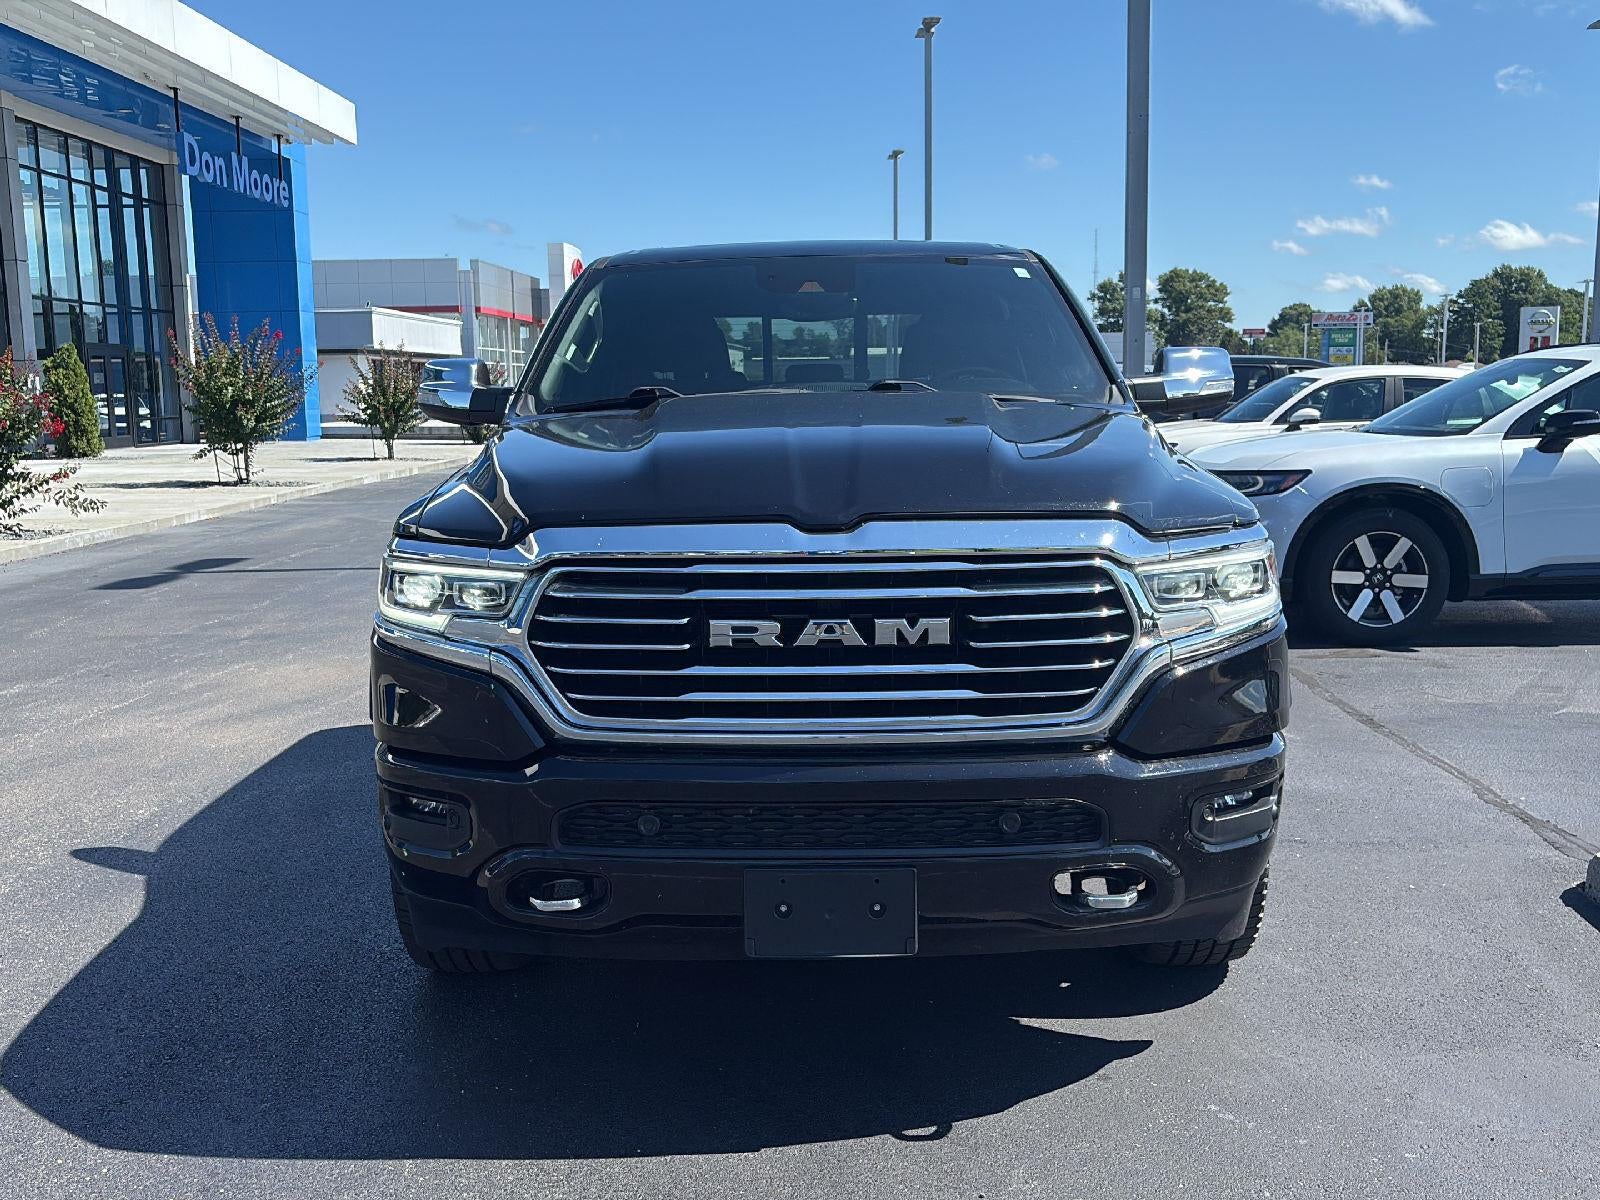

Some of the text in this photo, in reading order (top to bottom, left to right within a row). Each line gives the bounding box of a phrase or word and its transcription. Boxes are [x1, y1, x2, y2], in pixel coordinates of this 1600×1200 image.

[183, 132, 290, 208] Don Moore
[709, 618, 951, 648] RAM
